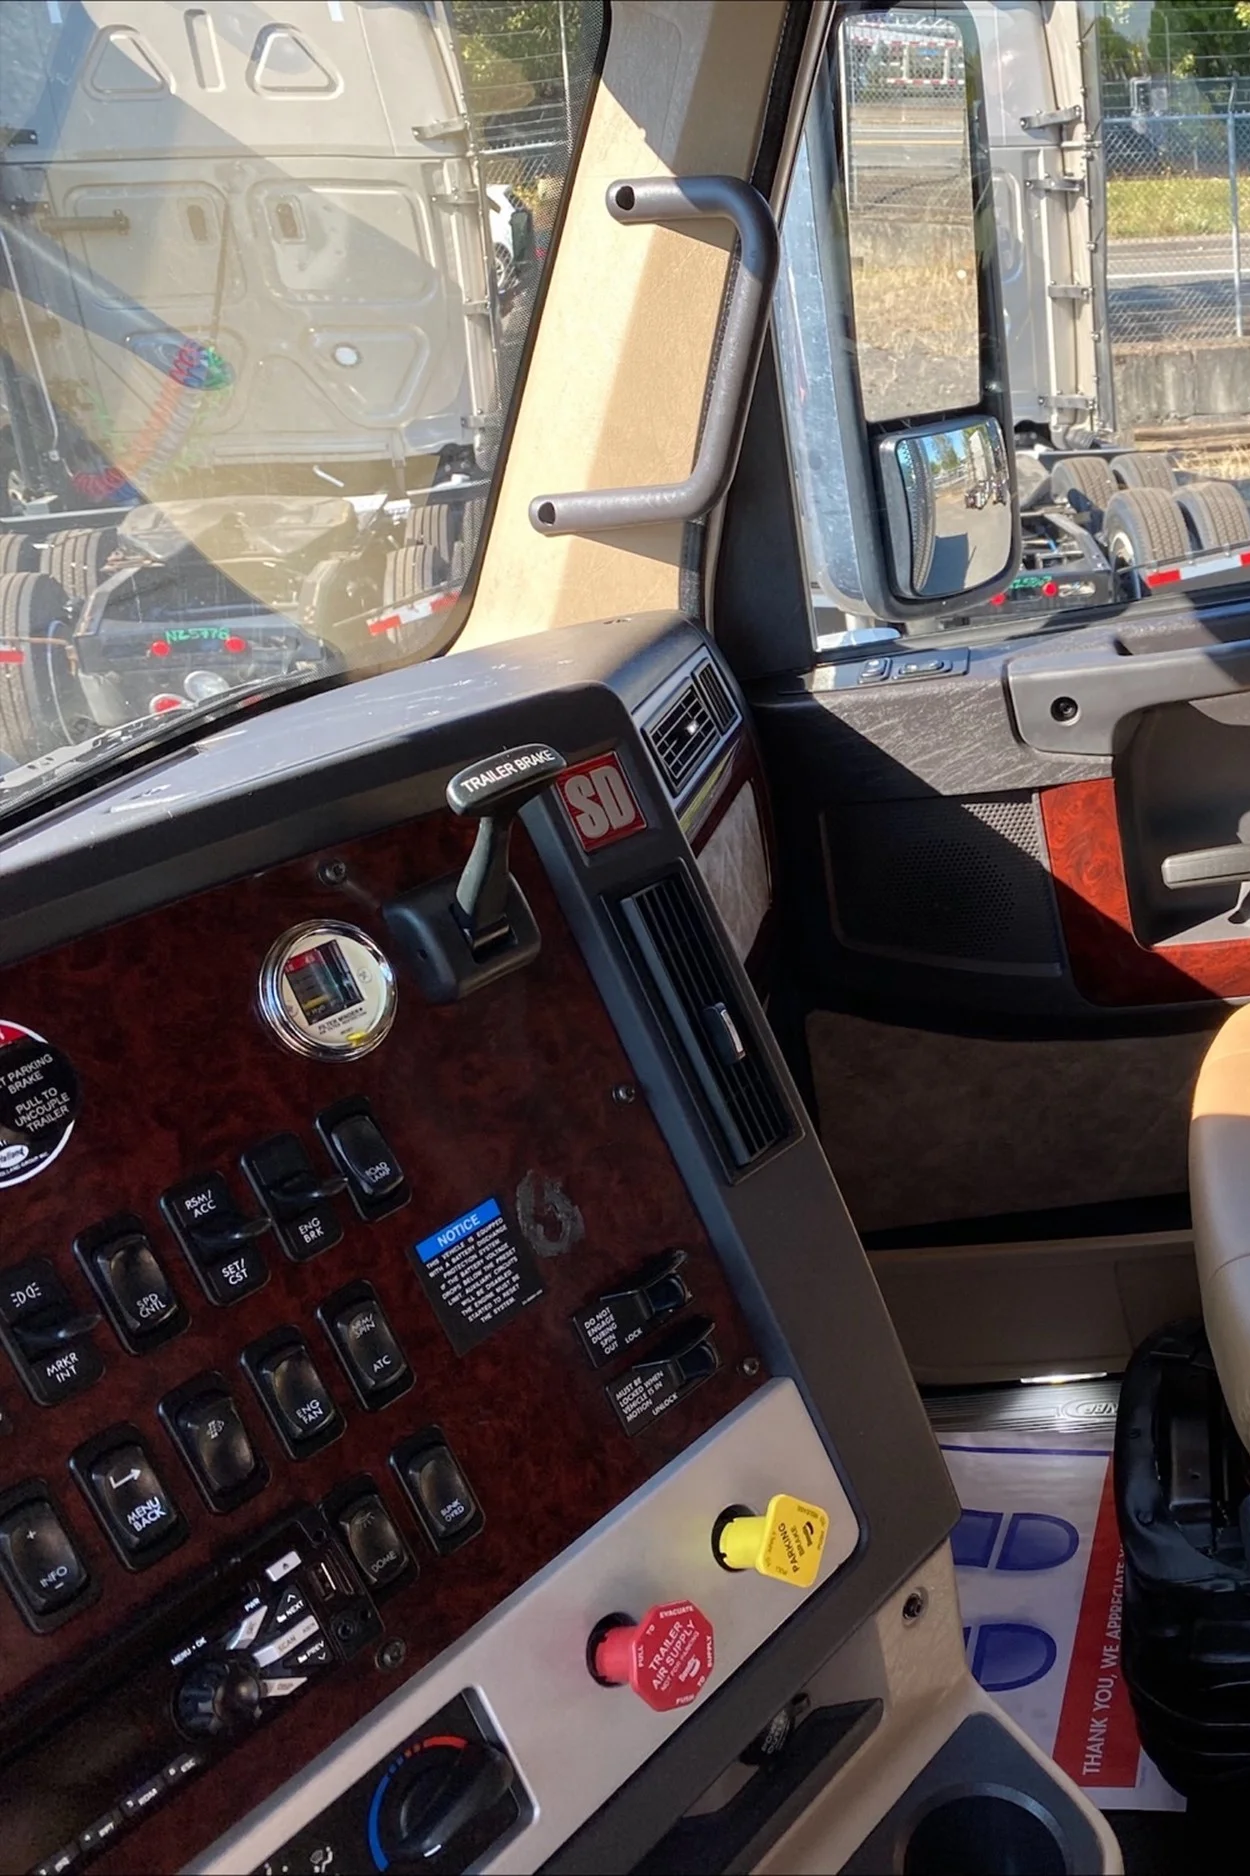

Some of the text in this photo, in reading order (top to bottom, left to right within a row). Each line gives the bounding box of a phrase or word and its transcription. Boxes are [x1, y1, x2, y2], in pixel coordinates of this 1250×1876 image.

[460, 750, 555, 793] TRAILER BRAKE
[565, 765, 636, 839] SD
[7, 1053, 54, 1082] PARKING
[7, 1070, 44, 1095] BRAKE
[15, 1087, 58, 1115] PULL TO
[15, 1092, 70, 1128] UNCOUPLE
[26, 1105, 70, 1133] TRAILER
[370, 1167, 392, 1183] LAMP
[184, 1189, 212, 1211] RSM/
[193, 1199, 217, 1218] ACC
[298, 1217, 321, 1235] ENG
[303, 1227, 325, 1244] BRK
[437, 1214, 480, 1247] NOTICE
[426, 1259, 440, 1269] THIS
[441, 1242, 465, 1260] VEHICLE
[476, 1217, 503, 1237] EQUIPPED
[429, 1266, 444, 1278] WITH
[451, 1245, 475, 1264] BATTERY
[477, 1224, 507, 1247] DISCHARGE
[222, 1258, 245, 1278] SET/
[442, 1247, 516, 1300] DROPS BELOW THE PRESET
[443, 1254, 478, 1278] PROTECTION
[447, 1275, 459, 1285] THE
[460, 1259, 484, 1278] BATTERY
[485, 1242, 509, 1260] VOLTAGE
[465, 1273, 492, 1294] AUXILIARY
[493, 1256, 518, 1275] CIRCUITS
[228, 1269, 249, 1285] CST
[136, 1293, 159, 1309] SPD
[461, 1274, 520, 1316] THE ENGINE MUST BE
[461, 1296, 475, 1306] WILL
[476, 1288, 484, 1297] BE
[468, 1303, 492, 1322] STARTED
[493, 1296, 501, 1304] TO
[502, 1283, 520, 1298] RESET
[139, 1303, 167, 1318] CNTL
[480, 1312, 492, 1323] THE
[584, 1306, 611, 1330] DO NOT
[587, 1316, 615, 1337] ENGAGE
[591, 1324, 618, 1344] DURING
[624, 1327, 643, 1344] LOCK
[600, 1334, 616, 1348] SPIN
[604, 1342, 619, 1355] OUT
[46, 1352, 79, 1377] MRKR
[56, 1366, 77, 1384] INT
[373, 1354, 391, 1373] ATC
[615, 1376, 642, 1400] MUST BE
[619, 1370, 664, 1408] LOCKED WHEN
[622, 1380, 663, 1415] VEHICLE IS IN
[296, 1399, 320, 1418] ENG
[303, 1407, 324, 1425] FAN
[626, 1399, 653, 1423] MOTION
[652, 1392, 679, 1416] UNLOCK
[127, 1496, 161, 1524] MENU
[133, 1509, 167, 1532] BACK
[778, 1522, 800, 1573] PARKING
[791, 1525, 805, 1557] BRAKE
[371, 1550, 397, 1574] DOME
[39, 1565, 68, 1588] INFO
[244, 1597, 261, 1612] PWR
[286, 1600, 304, 1616] NEXT
[645, 1624, 656, 1636] TO
[659, 1605, 694, 1619] EVACUATE
[171, 1636, 207, 1666] MENU OK
[278, 1636, 297, 1652] SCAN
[306, 1640, 325, 1657] PREV
[648, 1621, 683, 1671] TRAILER
[652, 1619, 695, 1690] AIR SUPPLY
[660, 1630, 700, 1691] NOT FOR PARKING
[1100, 1645, 1119, 1669] WE
[697, 1675, 705, 1687] TO
[1092, 1674, 1118, 1713] YOU,
[1082, 1717, 1109, 1776] THANK
[181, 1757, 196, 1773] ESC
